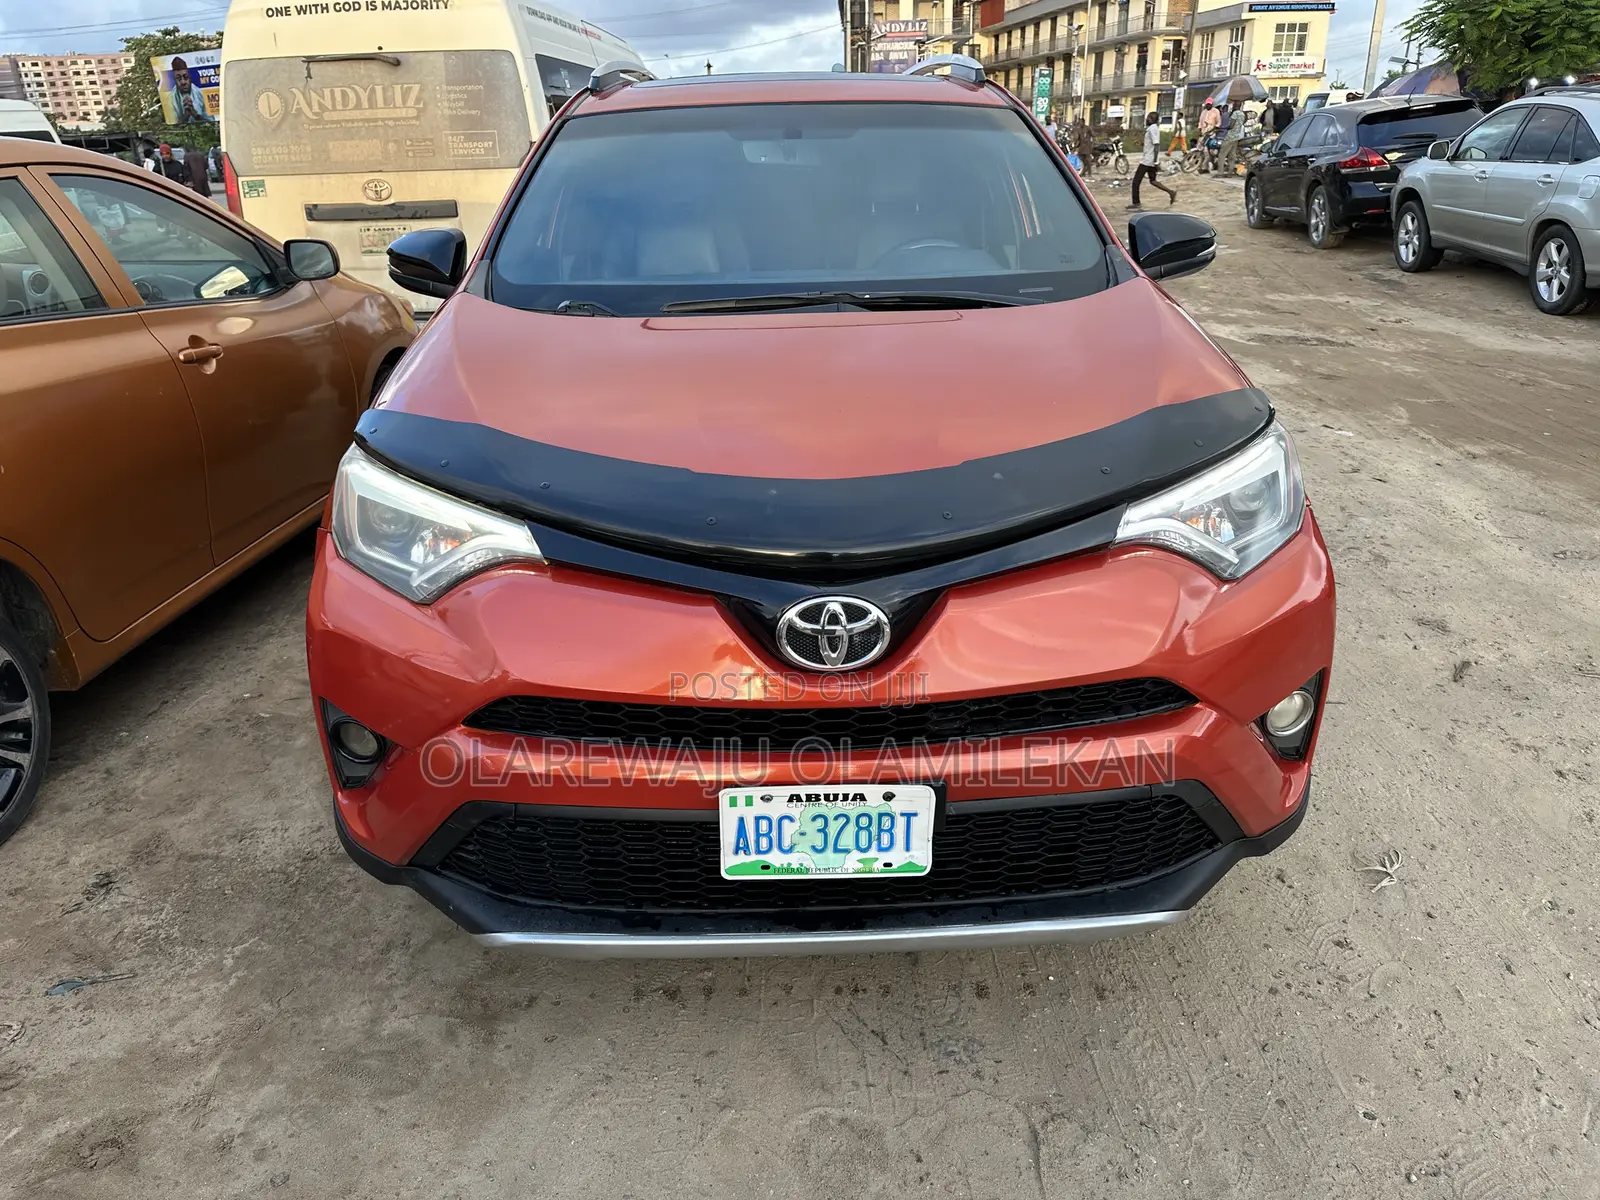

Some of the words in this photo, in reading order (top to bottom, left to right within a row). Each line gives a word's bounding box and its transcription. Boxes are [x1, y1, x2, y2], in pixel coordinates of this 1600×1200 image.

[266, 6, 292, 18] ONE
[295, 4, 330, 16] WITH
[333, 1, 362, 12] GOD
[366, 0, 378, 12] IS
[382, 0, 450, 11] MAJORITY
[872, 22, 928, 35] ANDYLIZ
[289, 84, 424, 120] ANDYLIZ
[786, 792, 867, 802] ABUJA
[732, 812, 918, 856] ABC-328BT
